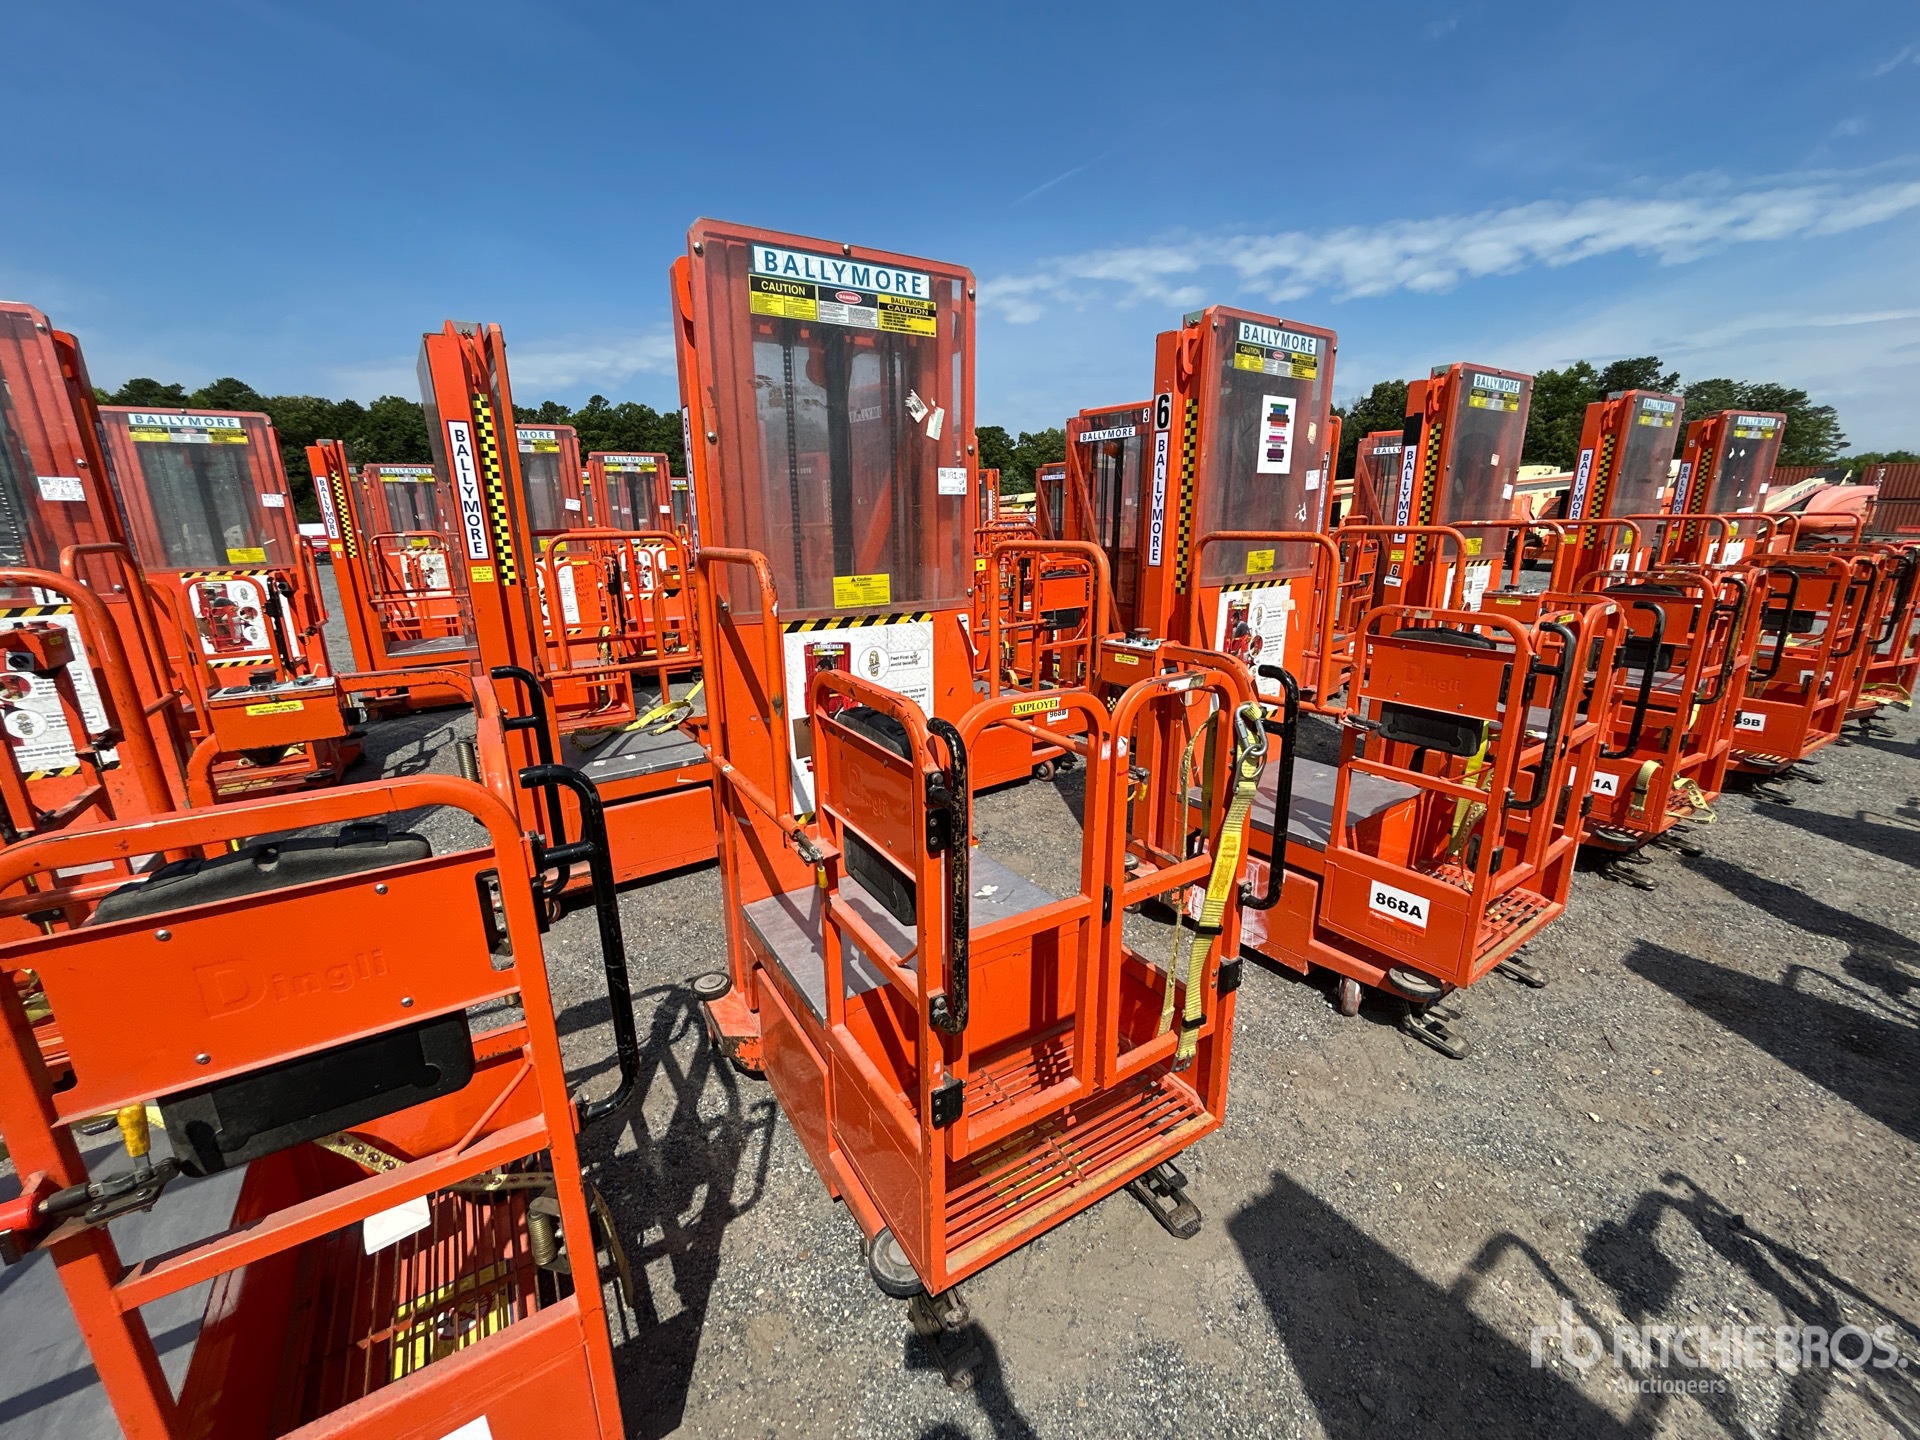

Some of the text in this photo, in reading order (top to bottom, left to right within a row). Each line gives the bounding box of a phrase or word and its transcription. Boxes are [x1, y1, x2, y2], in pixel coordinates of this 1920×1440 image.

[764, 250, 922, 295] BALLYMORE
[761, 280, 806, 296] CAUTION
[886, 304, 929, 316] CAUTION
[890, 297, 925, 308] BALLYMORE
[1240, 345, 1260, 355] CAUTION
[1244, 324, 1313, 352] BALLYMORE
[1476, 376, 1518, 392] BALLYMORE
[134, 414, 236, 428] BALLYMORE
[1144, 410, 1150, 422] 3
[1156, 394, 1170, 428] 6
[1082, 428, 1134, 442] BALLYMORE
[454, 429, 483, 554] BALLYMORE
[1152, 440, 1166, 560] BALLYMORE
[1572, 454, 1590, 519] BALLYMOR
[1674, 466, 1688, 514] BALLYMO
[319, 479, 337, 536] BALLYMORE
[1392, 565, 1398, 575] 6
[1404, 661, 1462, 692] Dingli
[1376, 892, 1422, 920] 868A
[193, 949, 389, 1019] Dingli
